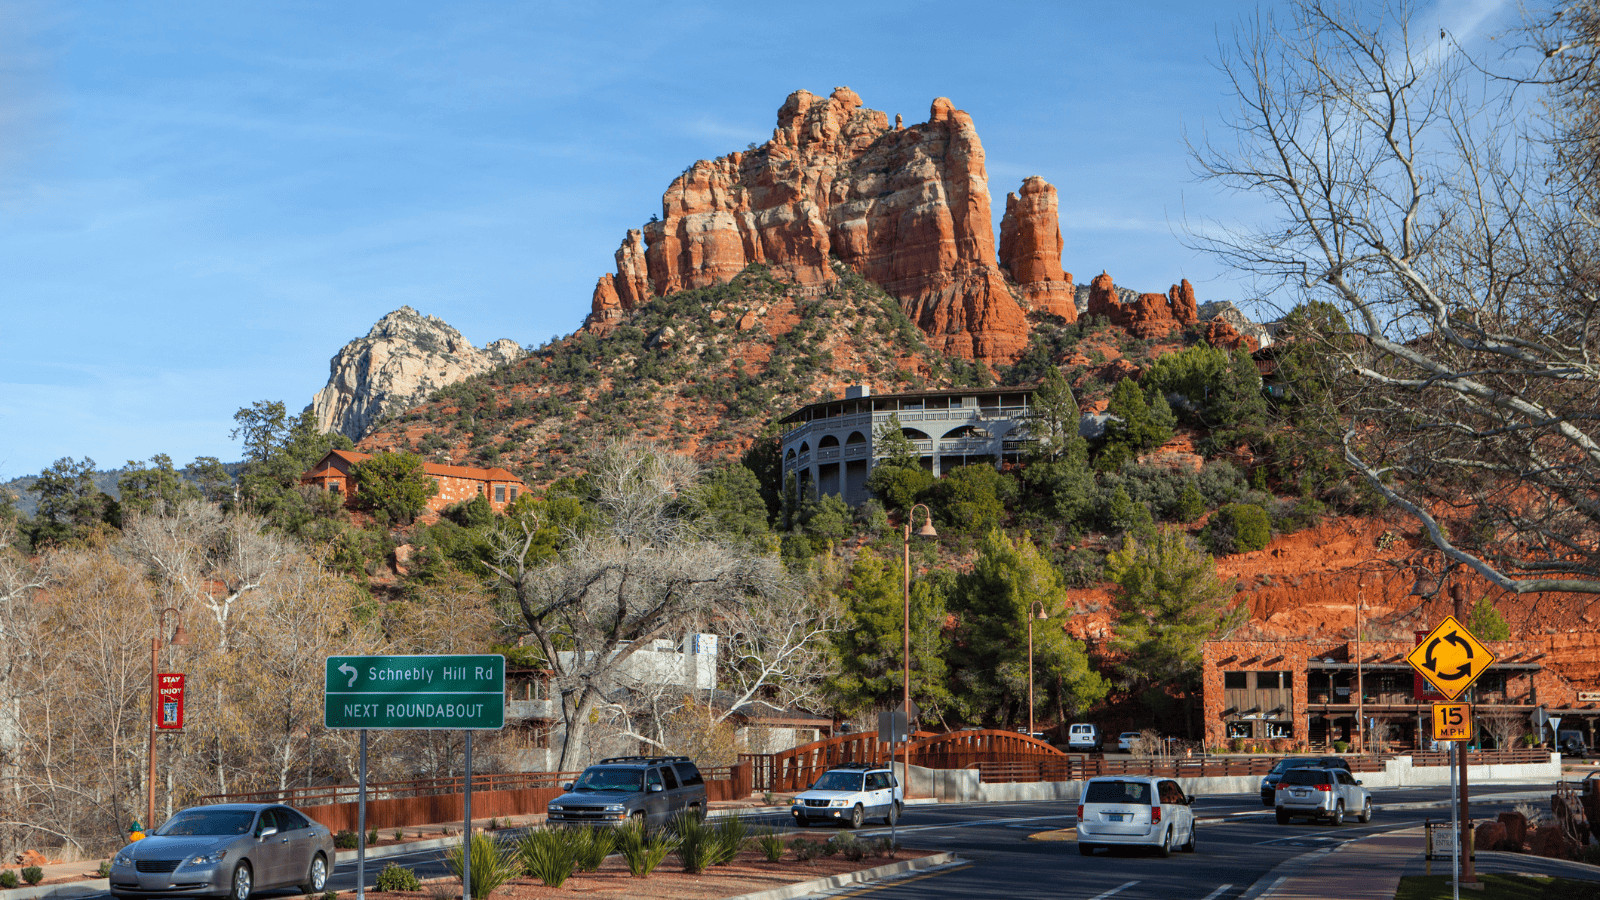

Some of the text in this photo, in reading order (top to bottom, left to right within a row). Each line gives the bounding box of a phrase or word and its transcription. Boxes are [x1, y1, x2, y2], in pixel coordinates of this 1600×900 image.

[369, 667, 493, 683] Schnebly Hill Rd
[344, 704, 484, 718] NEXT ROUNDABOUT
[1441, 708, 1463, 725] 15
